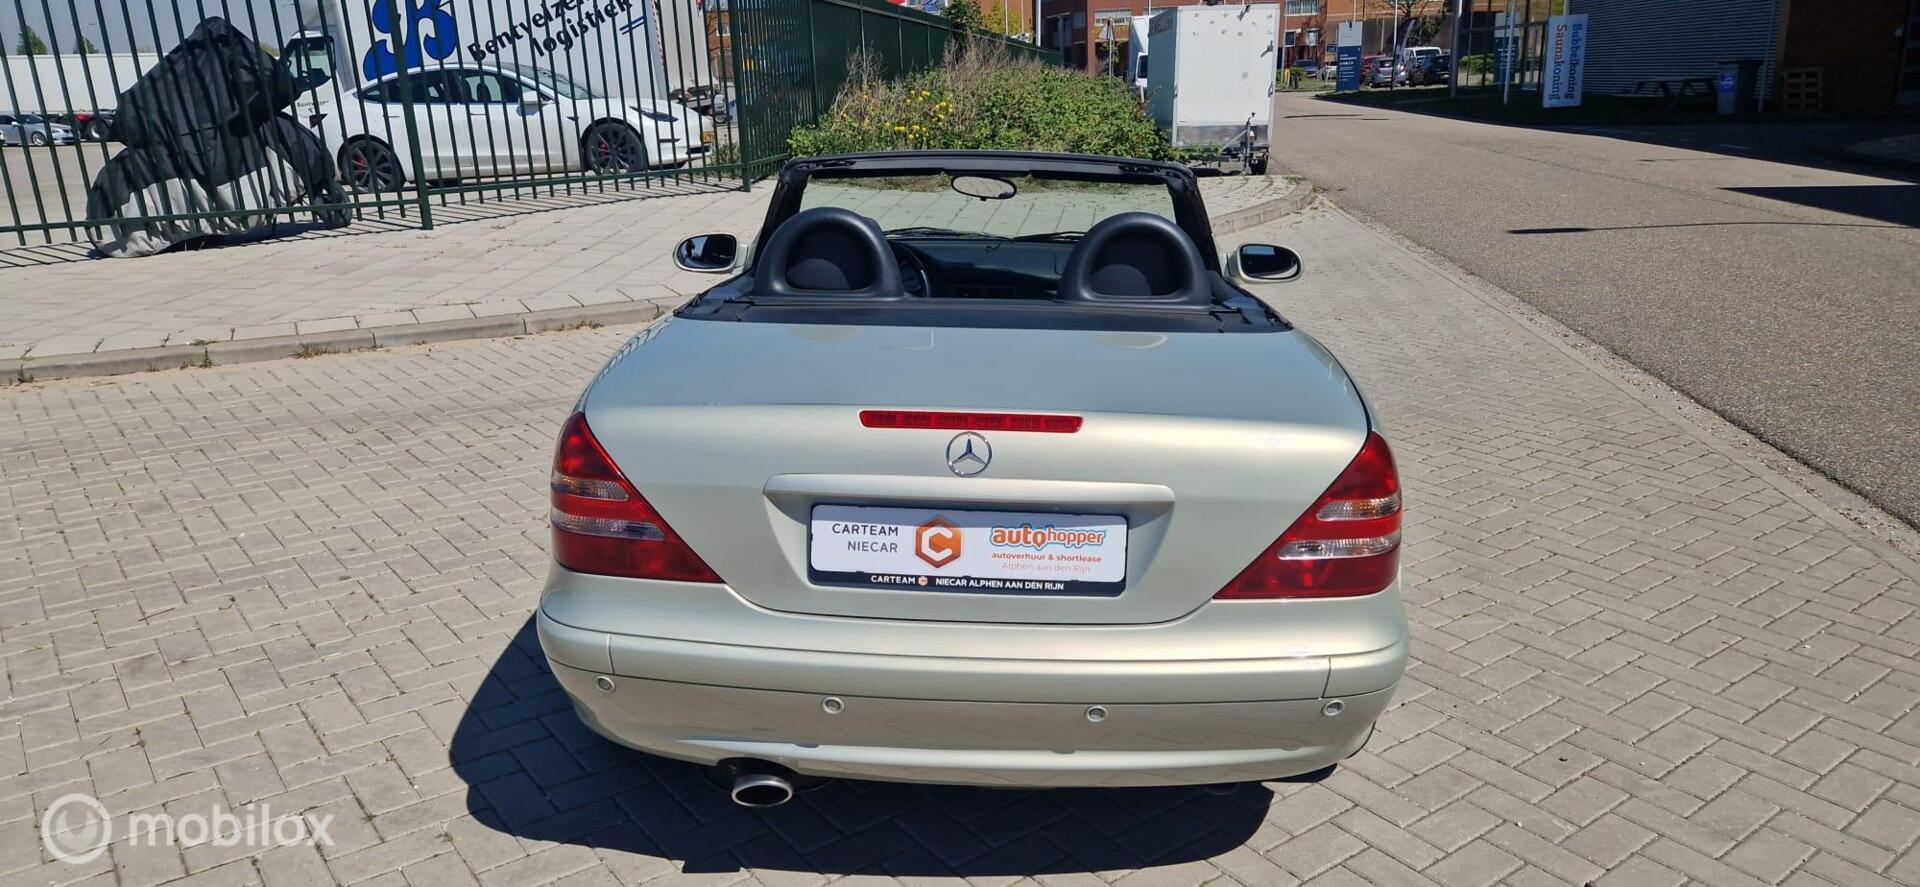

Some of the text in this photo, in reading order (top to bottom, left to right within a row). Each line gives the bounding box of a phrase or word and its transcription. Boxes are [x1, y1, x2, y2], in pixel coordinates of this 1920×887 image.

[467, 0, 590, 62] Bentvelze
[1549, 24, 1568, 100] Saunakoning
[1564, 23, 1583, 99] Bubbelkoning
[832, 523, 899, 537] CARTEAM
[992, 524, 1105, 548] autohopper
[847, 541, 898, 553] NIECAR
[991, 552, 1046, 561] autoverhuur
[1056, 554, 1102, 563] shortlease
[1002, 562, 1034, 571] Alphen
[1054, 563, 1071, 572] den
[1074, 564, 1091, 573] Rijn
[870, 575, 1064, 591] CARTEAM NIECAR ALPHEN AAN DEN RIJN
